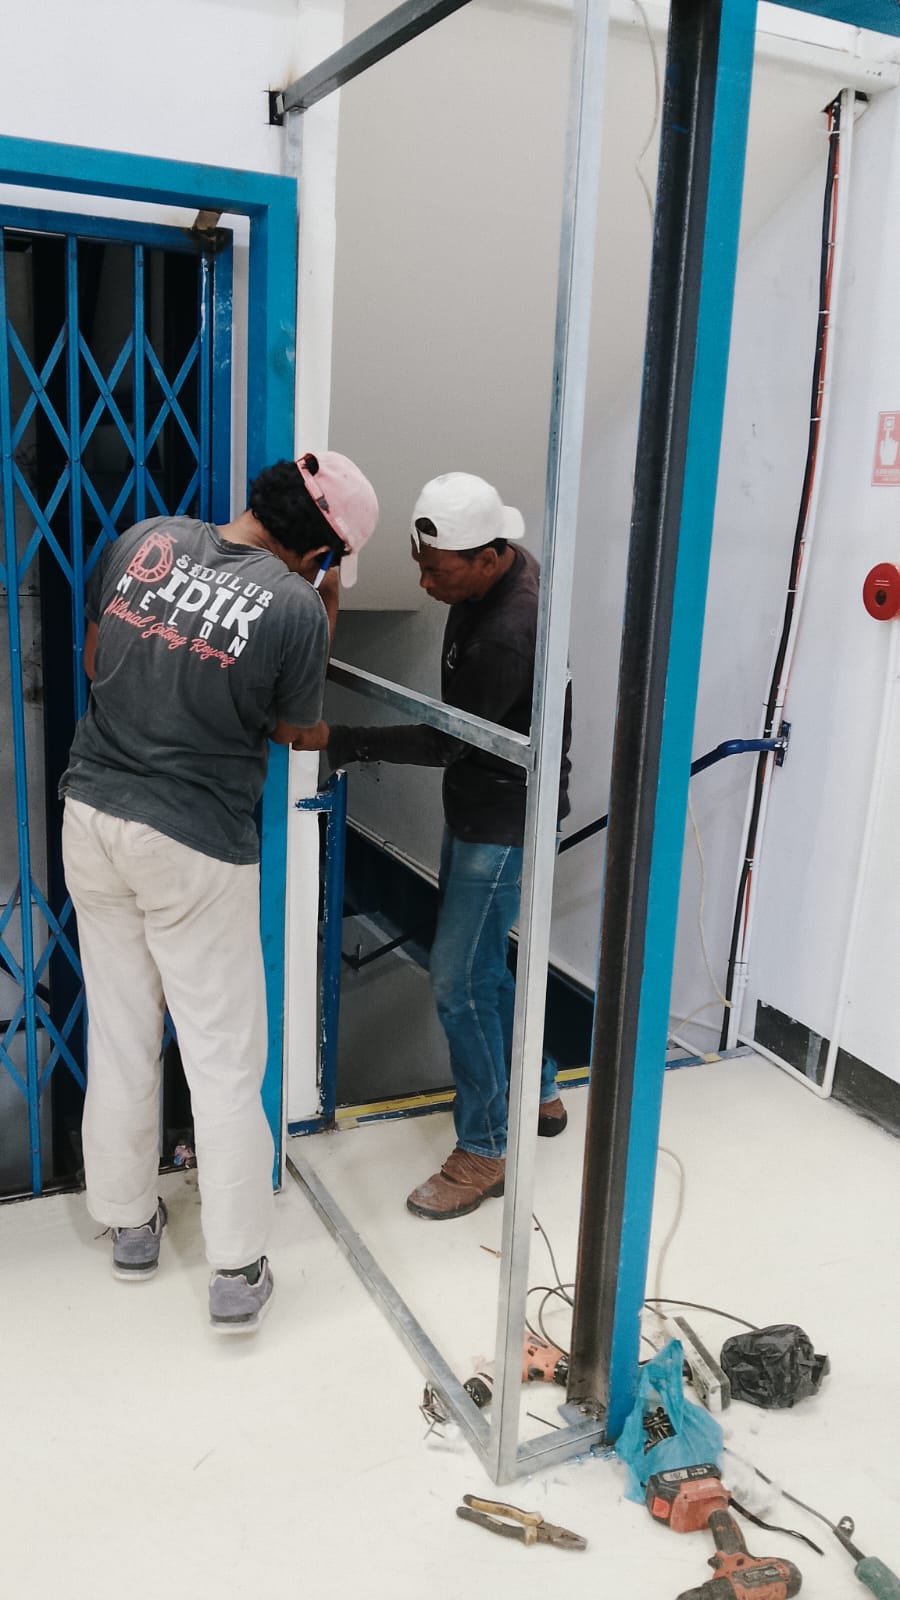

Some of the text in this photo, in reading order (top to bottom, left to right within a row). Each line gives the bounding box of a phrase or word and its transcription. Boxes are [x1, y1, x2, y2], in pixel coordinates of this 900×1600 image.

[176, 554, 274, 607] SEDULUR
[116, 573, 248, 658] MELON
[141, 622, 187, 650] Gotong
[189, 638, 236, 669] Royong
